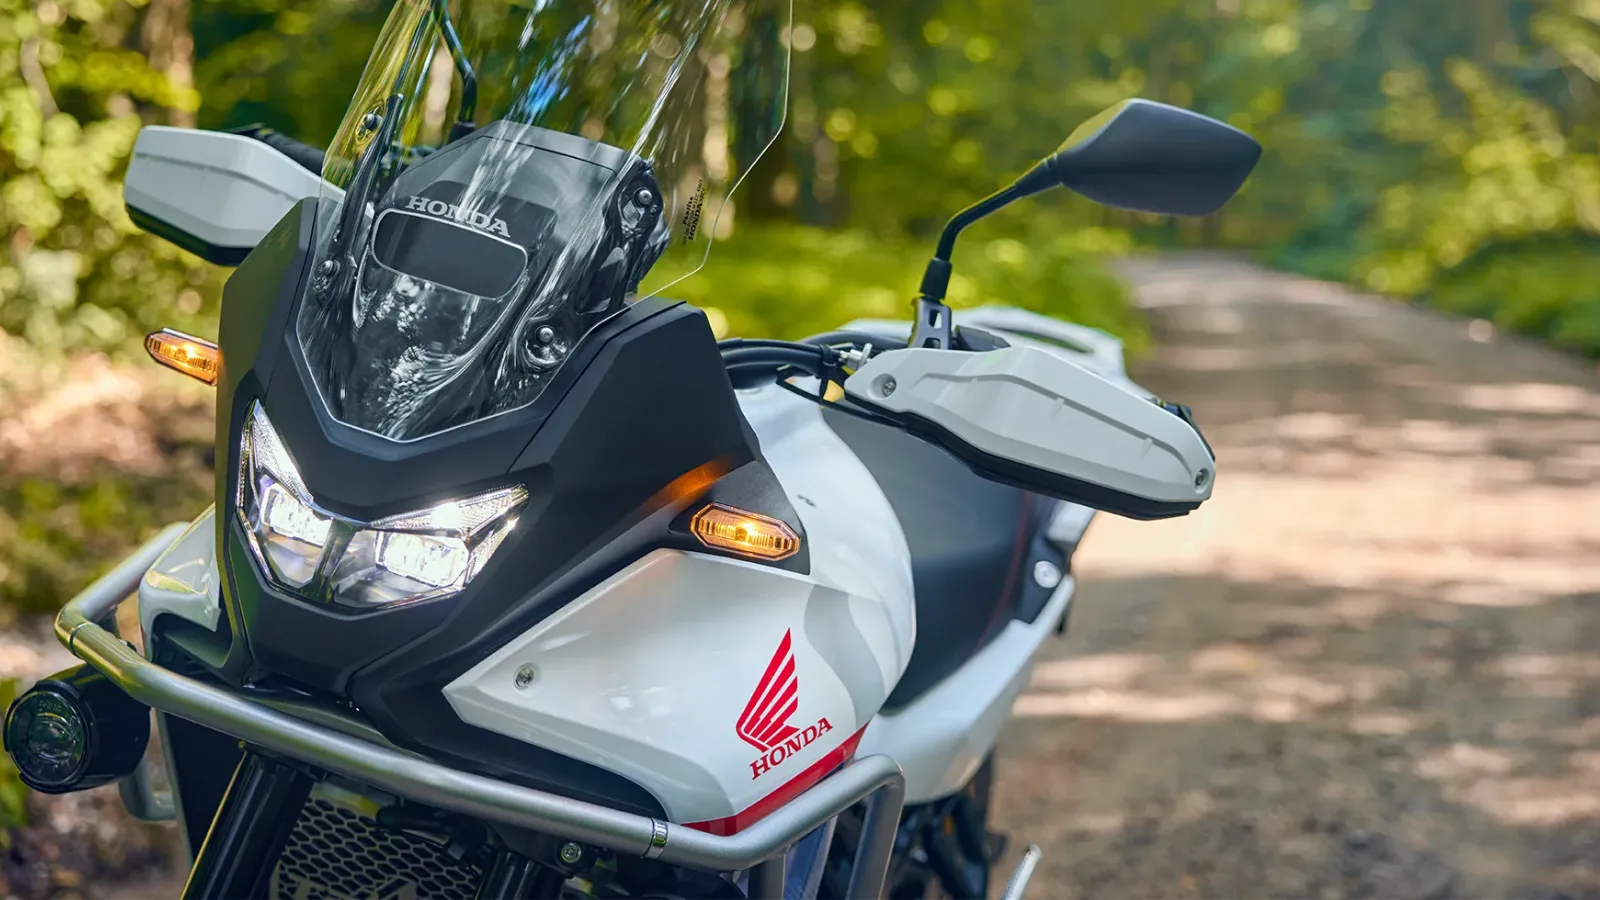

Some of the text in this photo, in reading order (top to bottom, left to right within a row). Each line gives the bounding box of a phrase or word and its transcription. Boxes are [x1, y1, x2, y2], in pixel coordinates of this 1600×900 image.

[405, 195, 511, 238] HONDA
[688, 203, 703, 241] HONDA
[749, 717, 833, 780] HONDA
